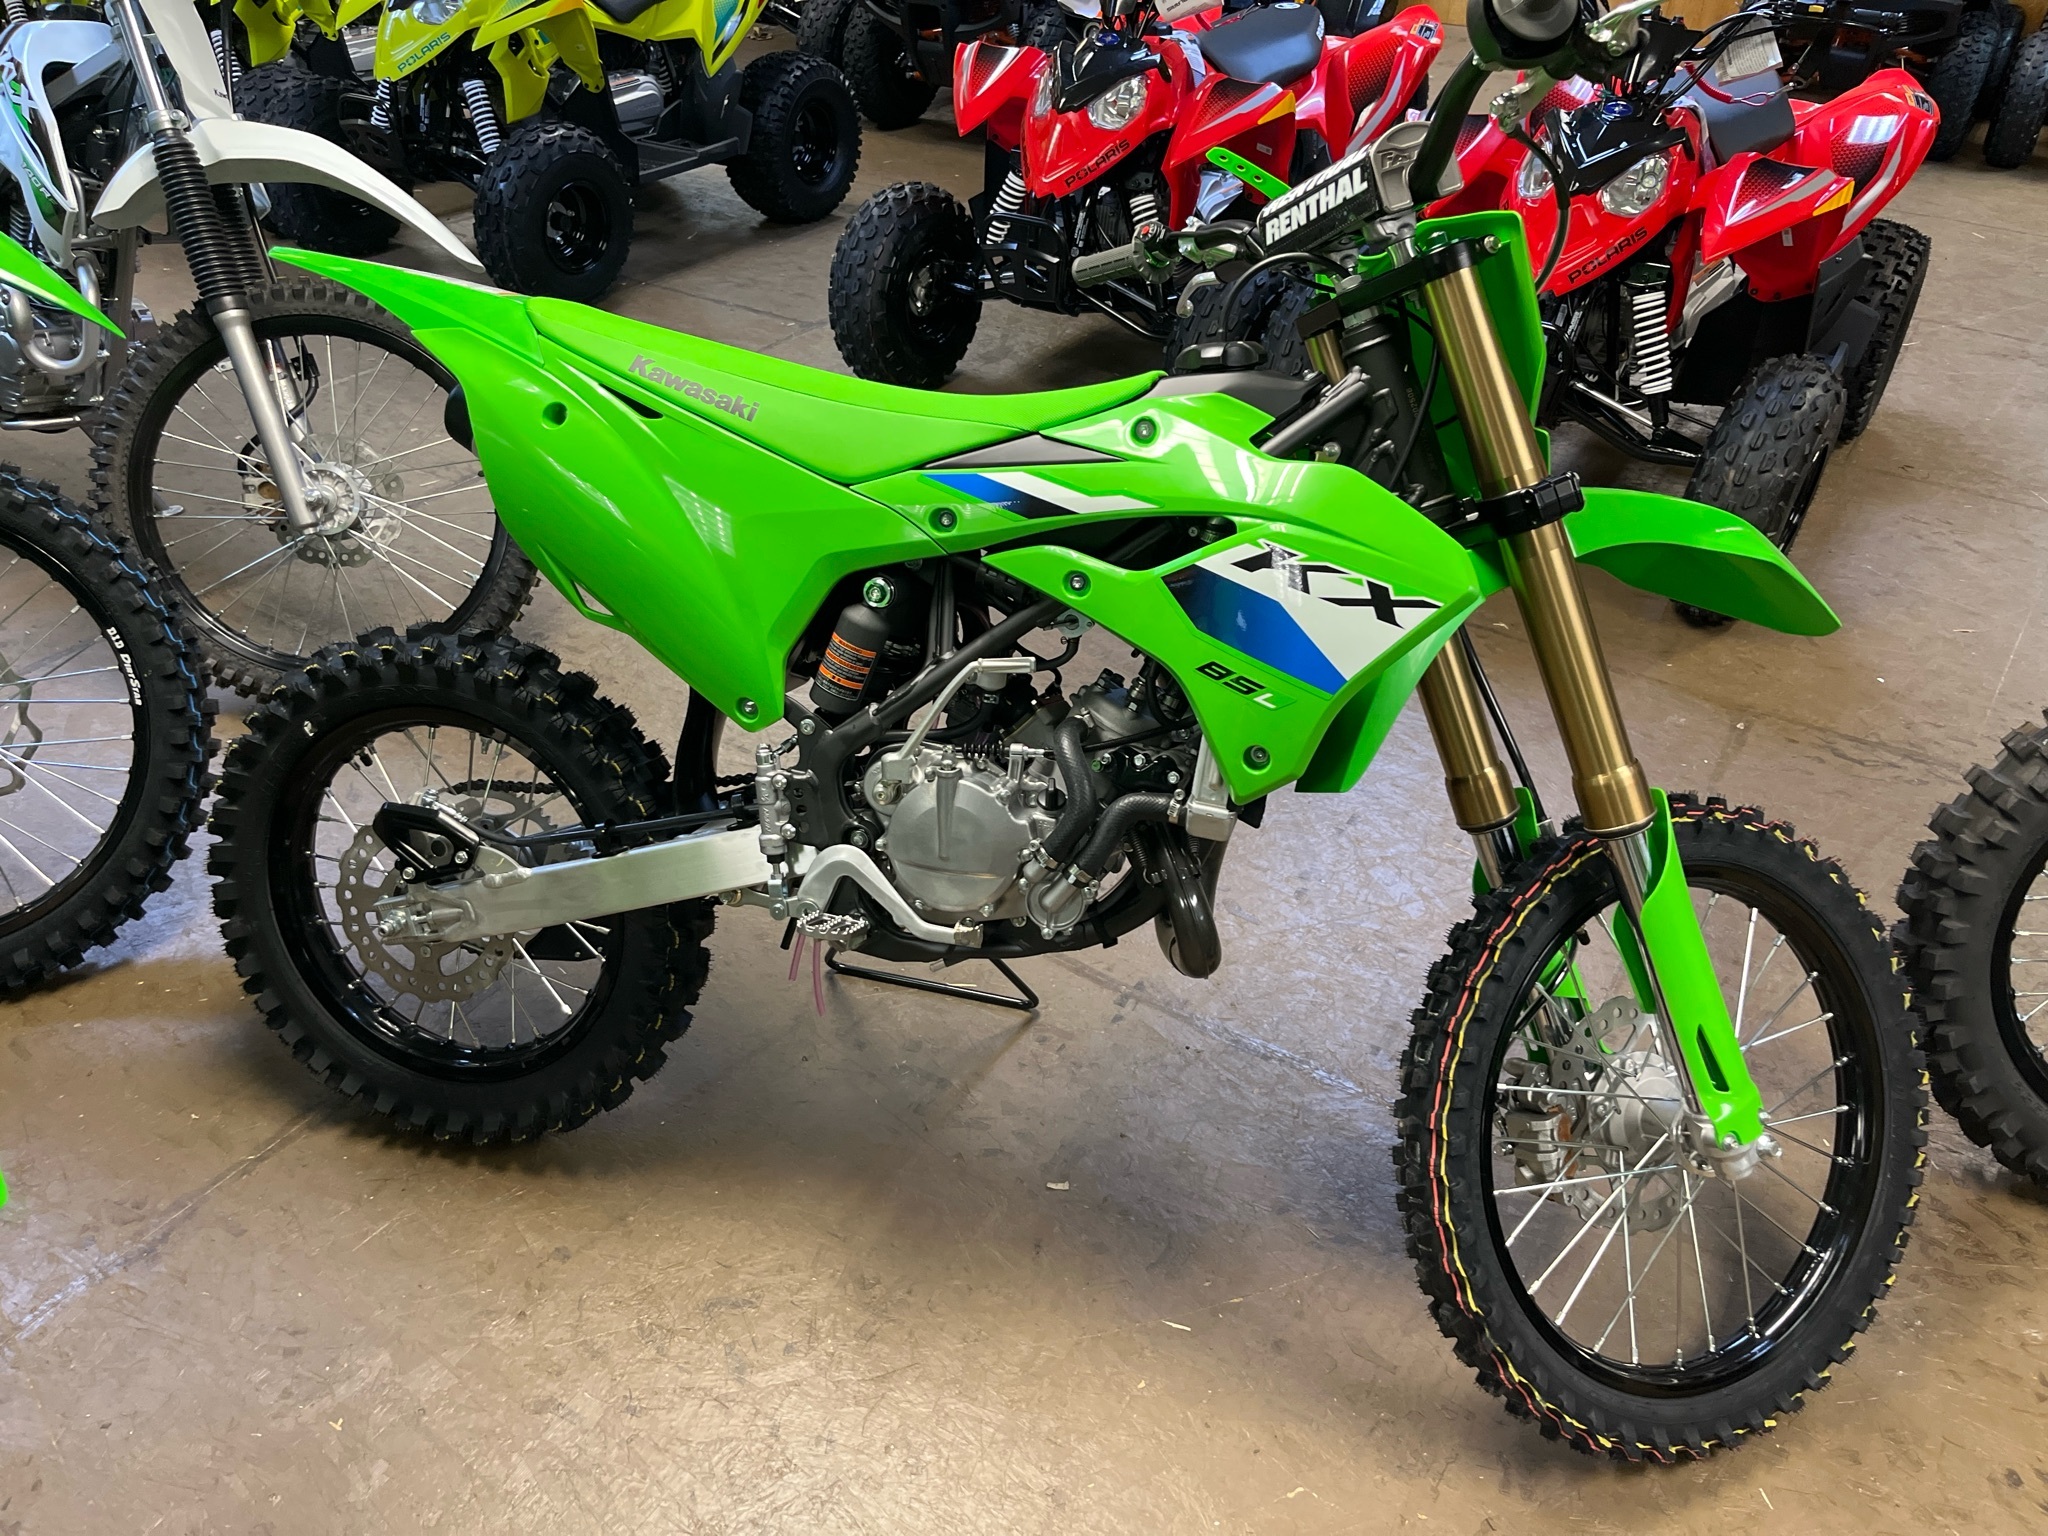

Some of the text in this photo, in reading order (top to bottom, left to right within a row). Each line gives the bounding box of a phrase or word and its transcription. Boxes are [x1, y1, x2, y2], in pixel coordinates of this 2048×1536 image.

[397, 31, 451, 73] POLARIS
[1064, 139, 1130, 188] POLARIS
[1265, 166, 1368, 246] RENTHAL
[1567, 226, 1648, 284] POLARIS
[628, 354, 760, 422] Kawasaki
[1231, 541, 1443, 630] KX
[1195, 661, 1277, 710] 85L
